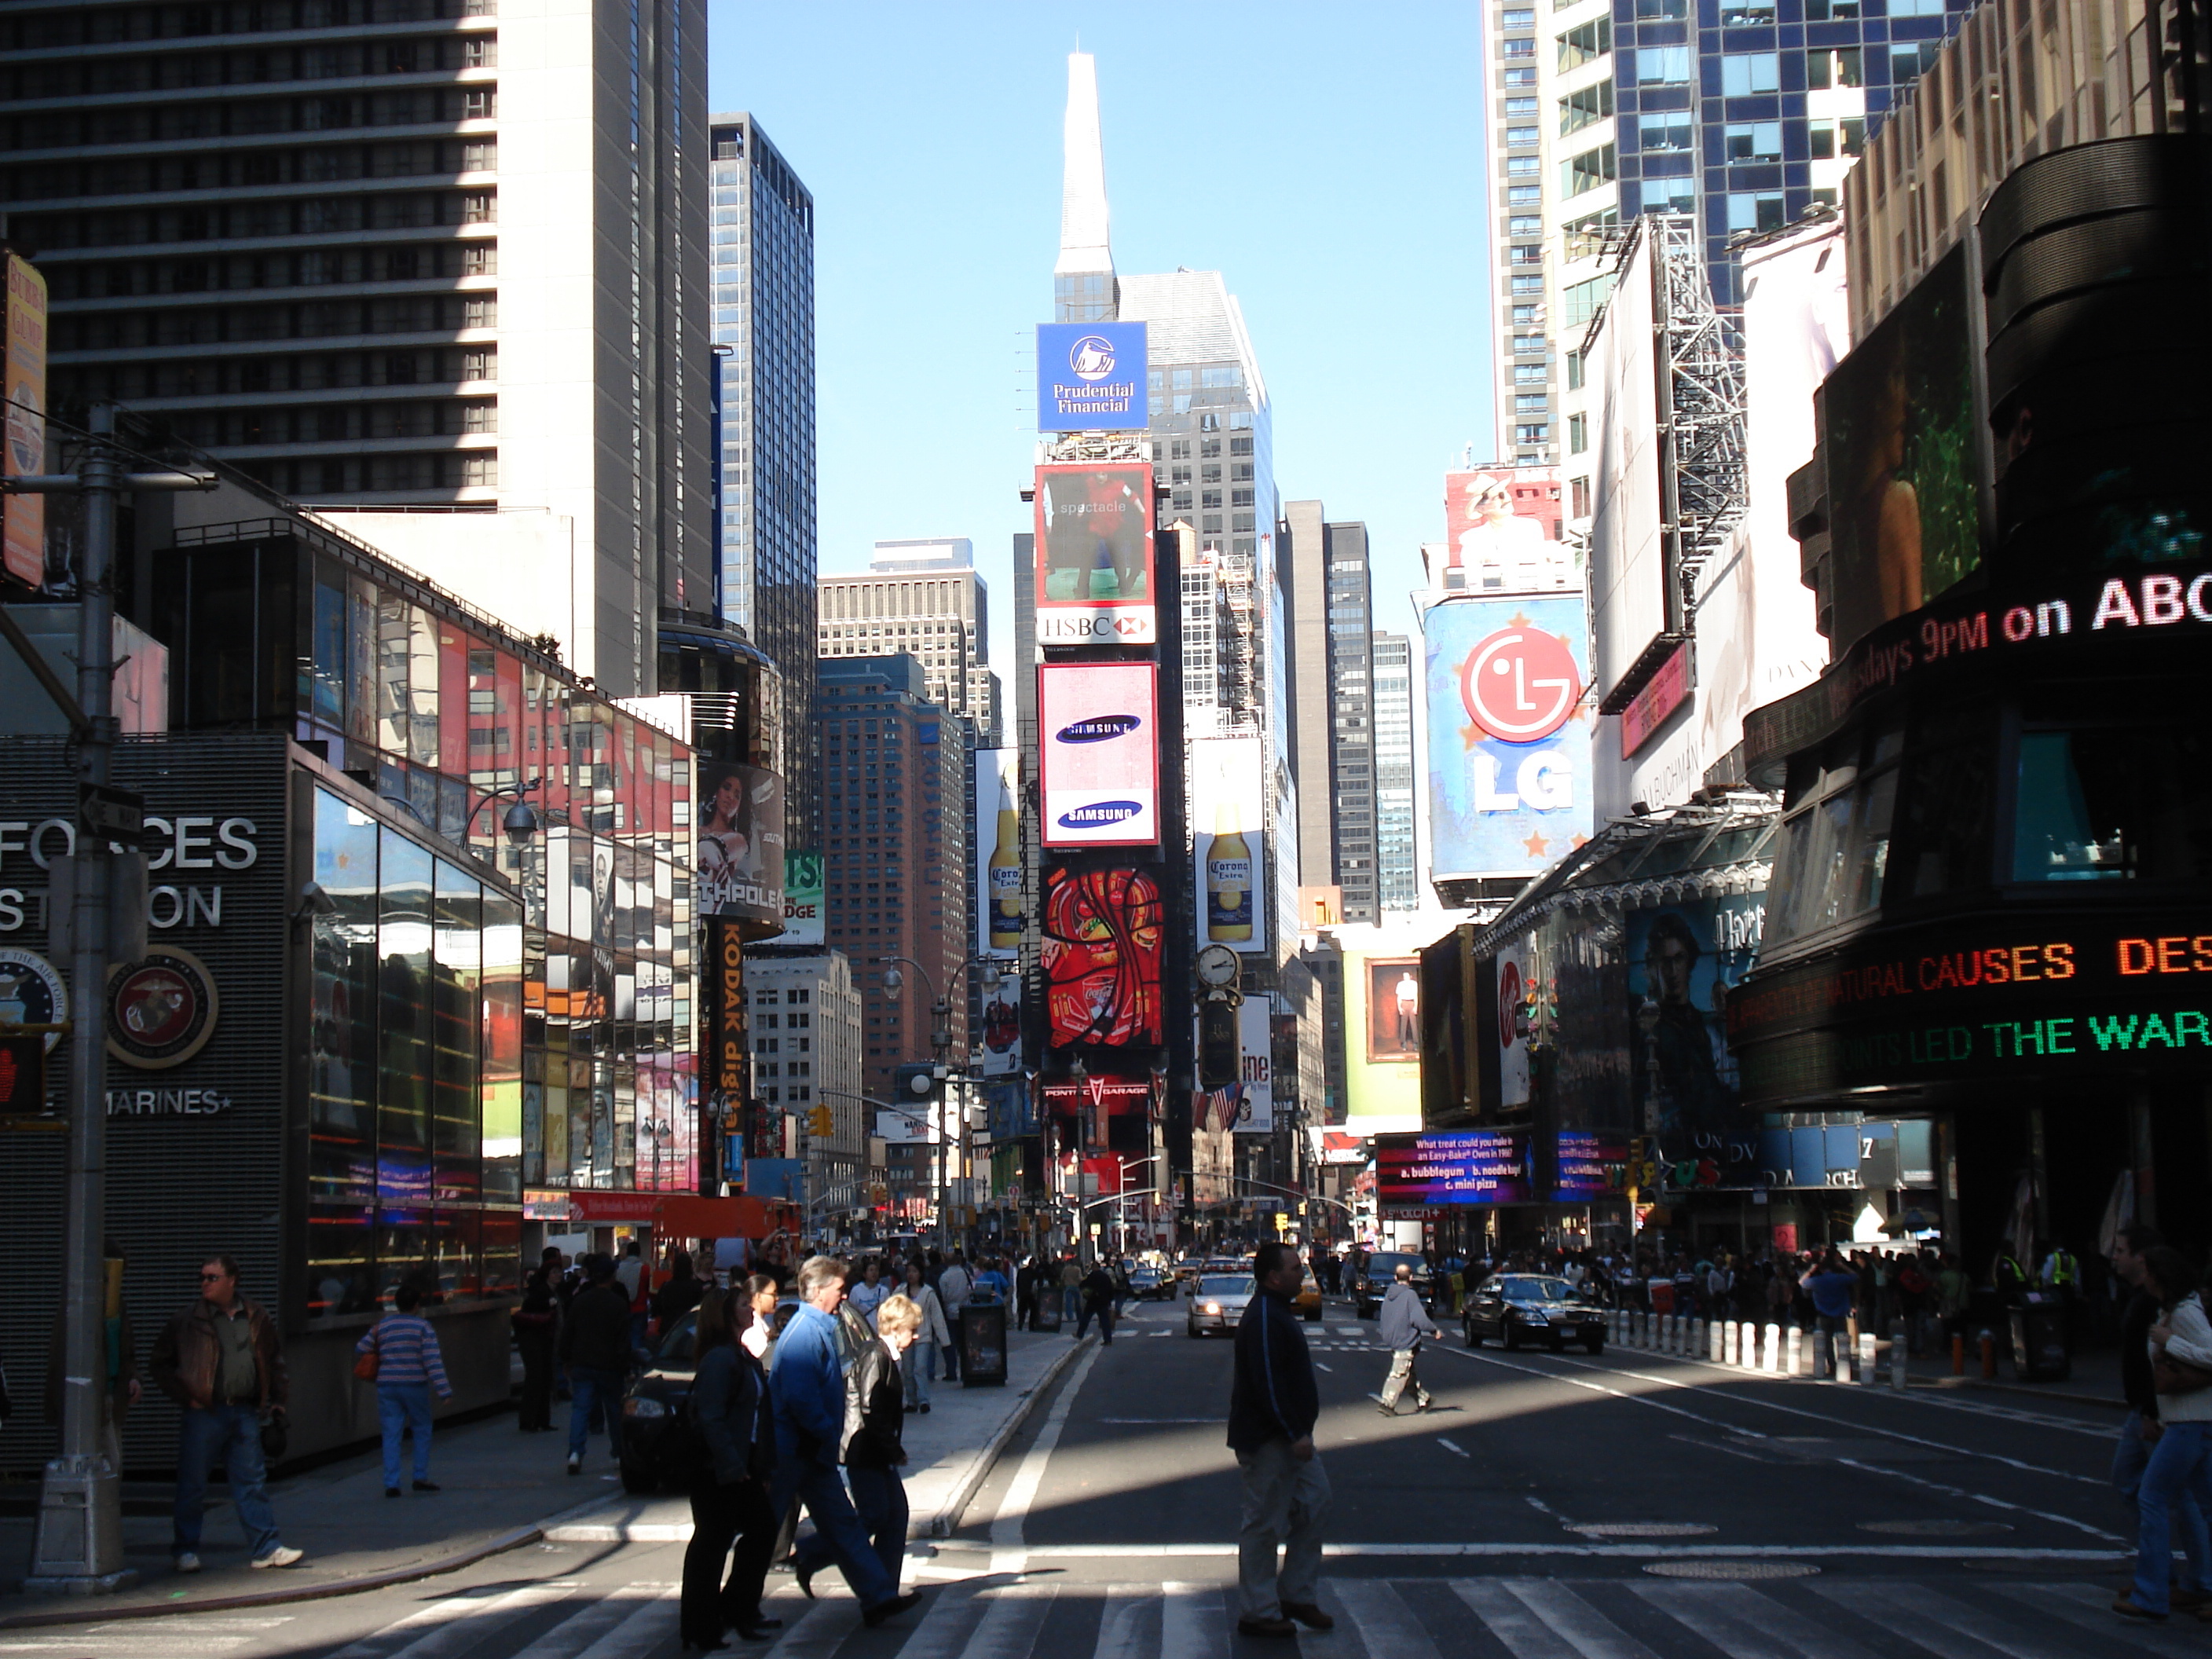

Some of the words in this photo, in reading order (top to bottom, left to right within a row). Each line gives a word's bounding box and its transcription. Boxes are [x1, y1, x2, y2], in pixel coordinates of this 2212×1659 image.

[1053, 383, 1134, 397] Prudential
[1057, 399, 1130, 413] Financial
[1060, 501, 1126, 515] spectacle
[1046, 617, 1110, 636] HSBC
[1920, 610, 1990, 664] 9PM
[2001, 598, 2072, 643] on
[1474, 750, 1573, 812] LG
[1068, 808, 1133, 822] SAMSUNG
[0, 817, 258, 870] FOCES
[1210, 862, 1249, 873] Corona
[1919, 943, 2075, 991] CAUSES
[724, 923, 742, 1033] KODAK
[1910, 1025, 1972, 1063] LED
[1982, 1017, 2076, 1057] THE
[1102, 1087, 1148, 1096] GARAGE
[1416, 1139, 1437, 1149] What
[1438, 1140, 1456, 1149] treat
[1458, 1138, 1478, 1148] could
[1478, 1139, 1492, 1149] you
[1417, 1152, 1428, 1161] an
[1472, 1149, 1490, 1159] Oven
[1401, 1169, 1410, 1178] a.
[1412, 1166, 1465, 1179] bubblegum
[1472, 1164, 1481, 1176] b.
[1482, 1163, 1507, 1175] noodle
[1445, 1181, 1454, 1190] c.
[1455, 1179, 1476, 1190] mini
[1476, 1179, 1498, 1191] pizza
